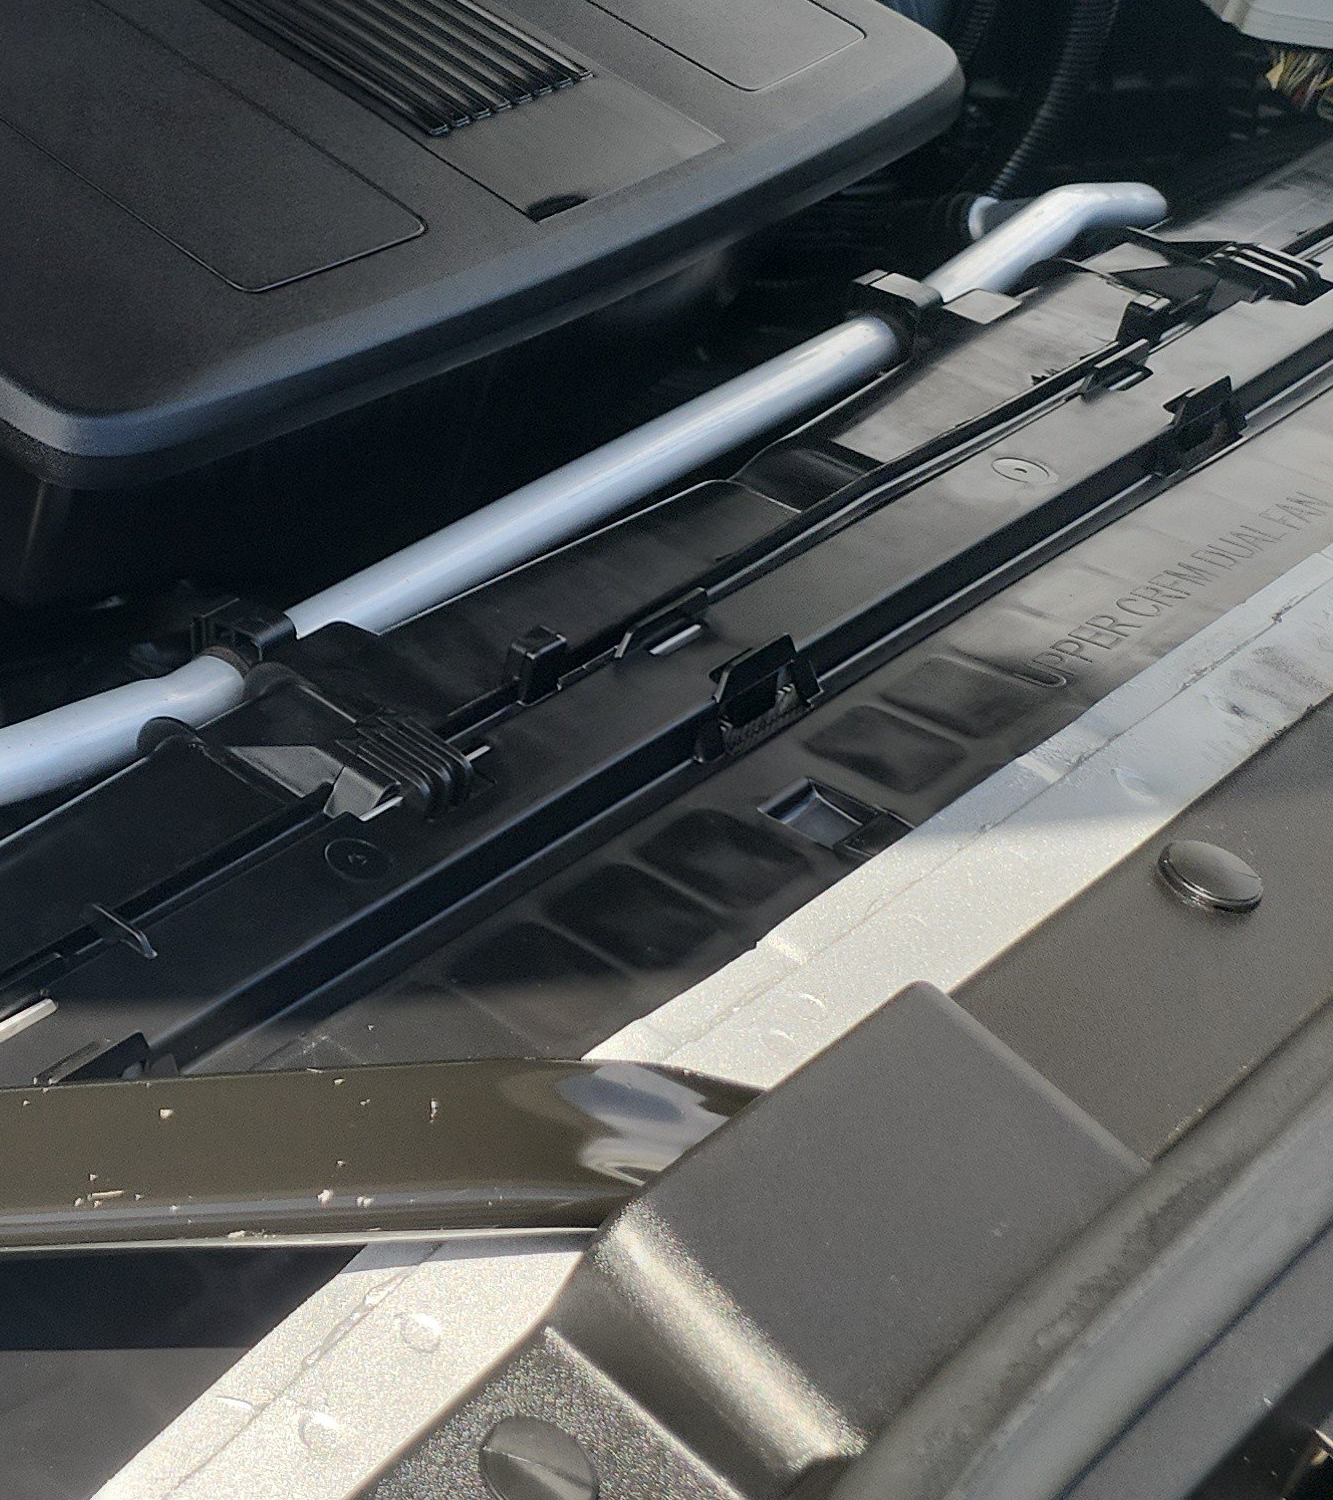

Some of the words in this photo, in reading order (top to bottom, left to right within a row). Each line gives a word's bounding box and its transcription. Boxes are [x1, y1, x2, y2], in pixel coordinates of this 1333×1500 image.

[1012, 613, 1142, 688] UPPER
[1190, 524, 1289, 571] DUAL
[1258, 491, 1333, 531] FAN
